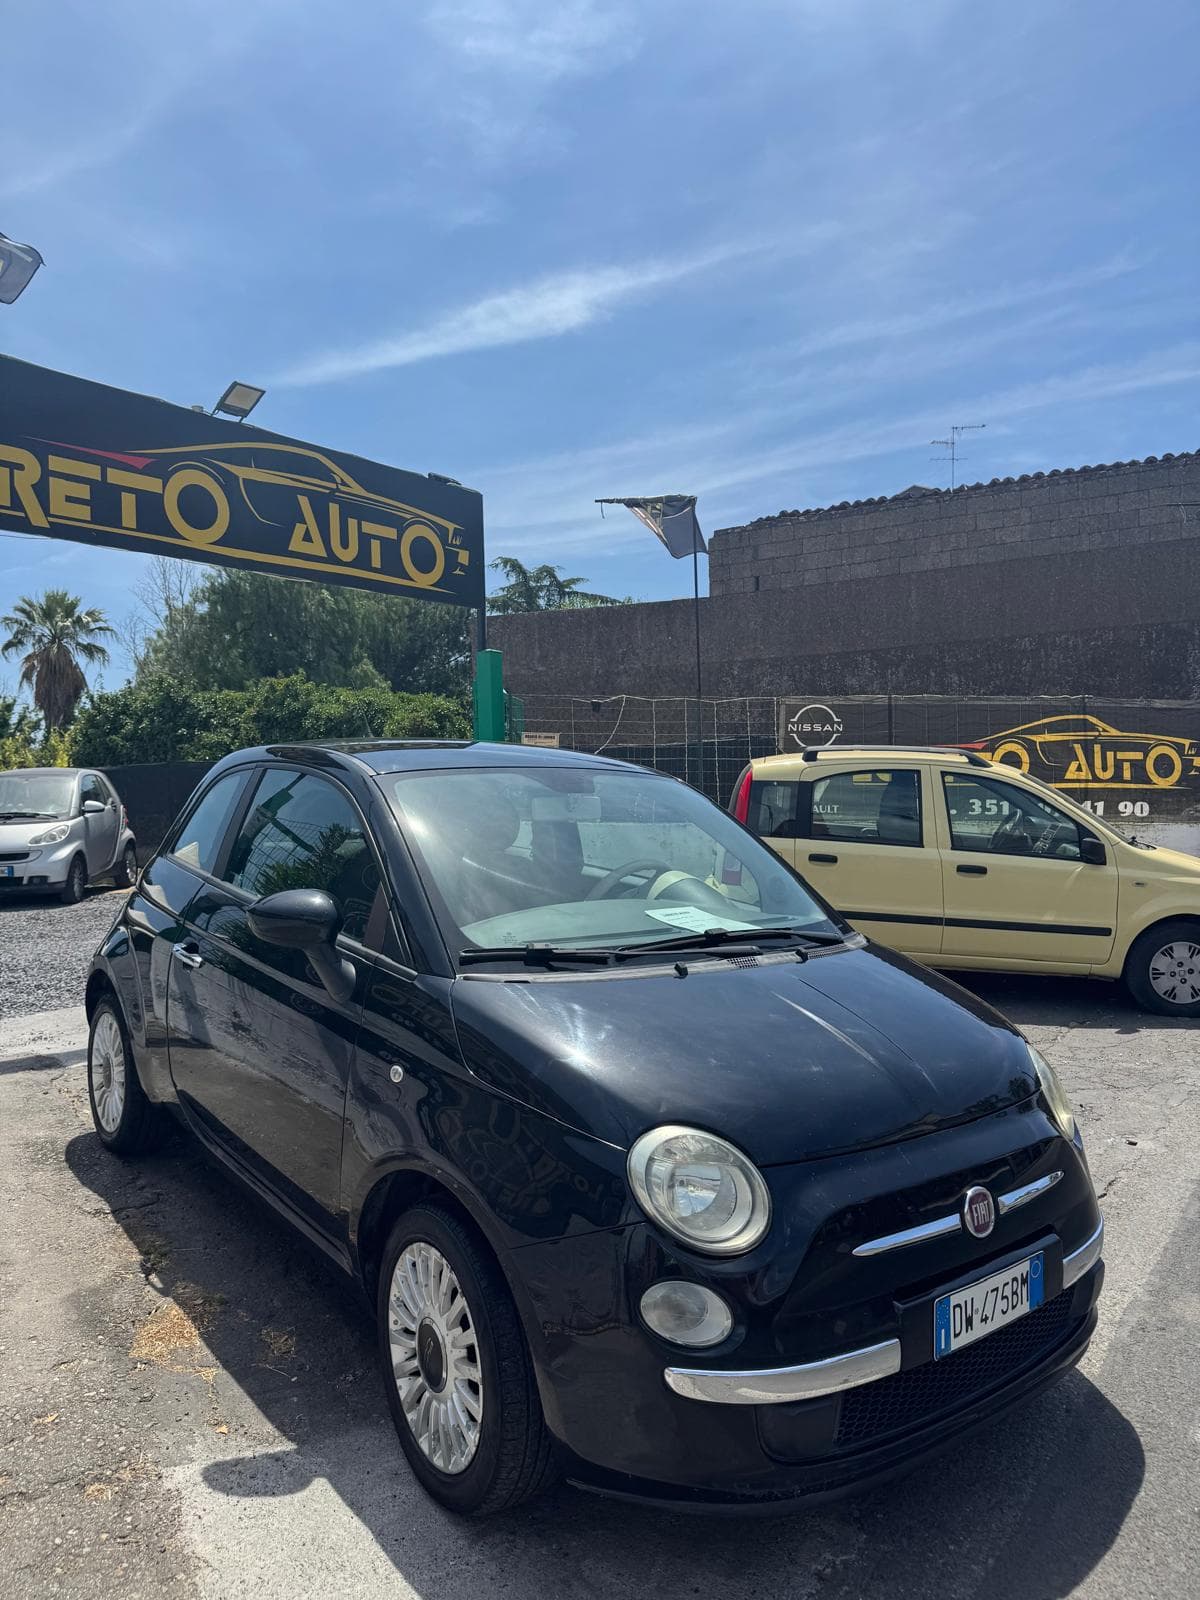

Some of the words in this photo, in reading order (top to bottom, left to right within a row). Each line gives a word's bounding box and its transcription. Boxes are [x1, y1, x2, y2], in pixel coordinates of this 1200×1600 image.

[288, 495, 445, 587] AUTO
[787, 723, 843, 732] NISSAN
[1064, 743, 1182, 786] AUTO
[968, 798, 1010, 815] 351
[1118, 801, 1150, 817] 90
[971, 1200, 990, 1226] FIAT
